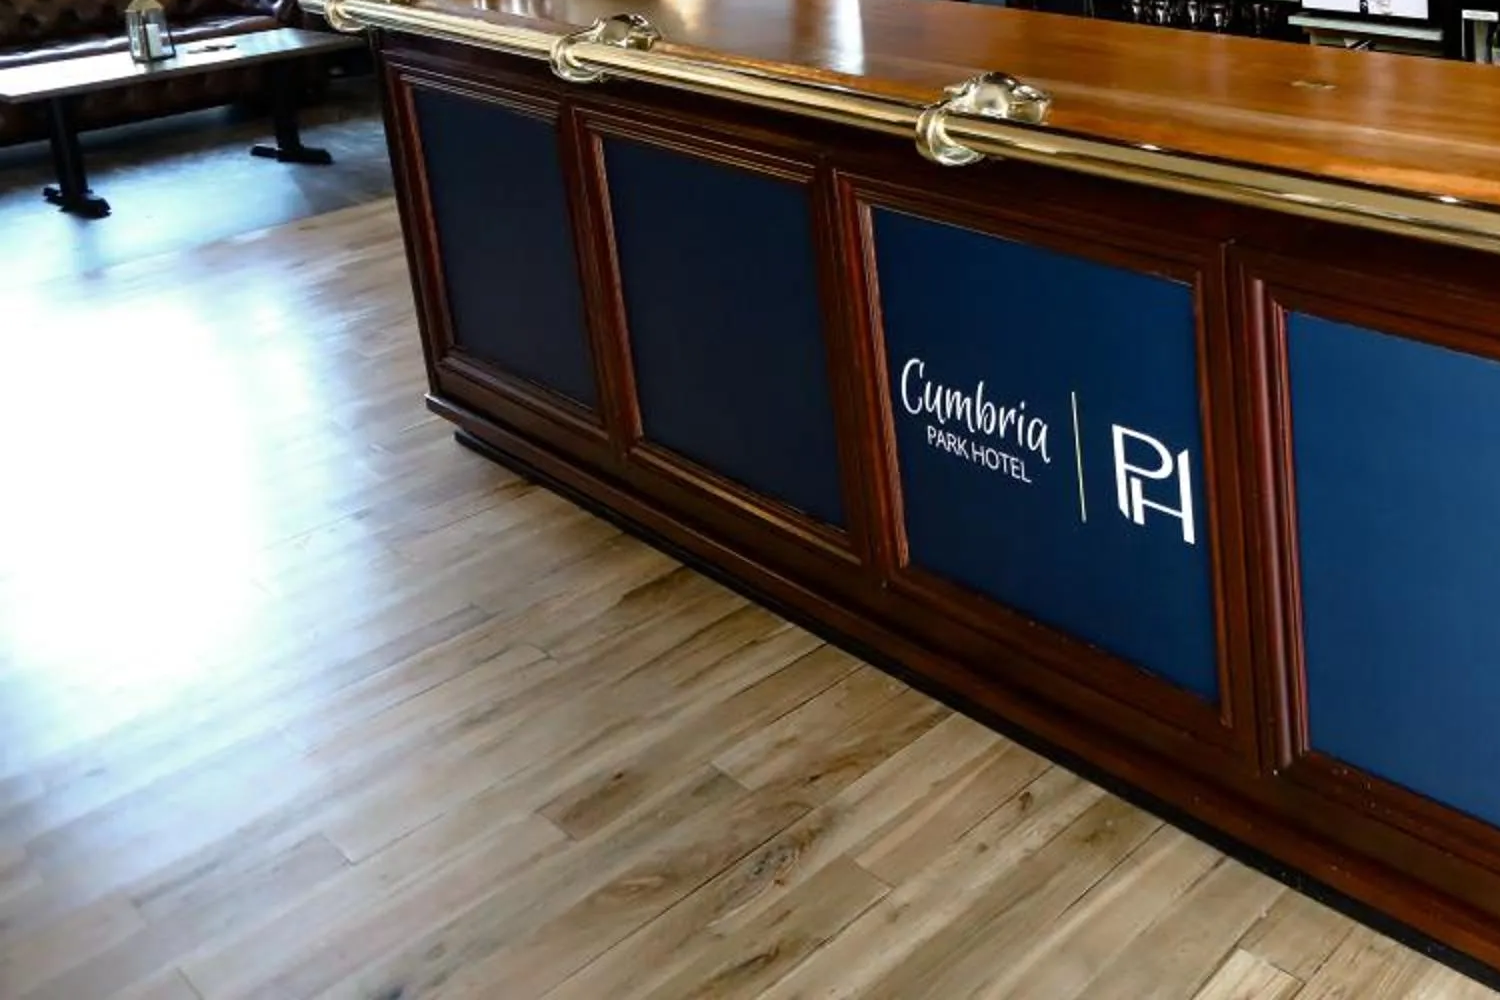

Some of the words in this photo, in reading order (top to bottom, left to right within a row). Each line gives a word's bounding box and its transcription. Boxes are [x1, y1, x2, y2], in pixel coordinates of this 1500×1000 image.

[901, 357, 1051, 465] Cumbria
[927, 425, 970, 460] PARK
[971, 441, 1033, 484] HOTEL
